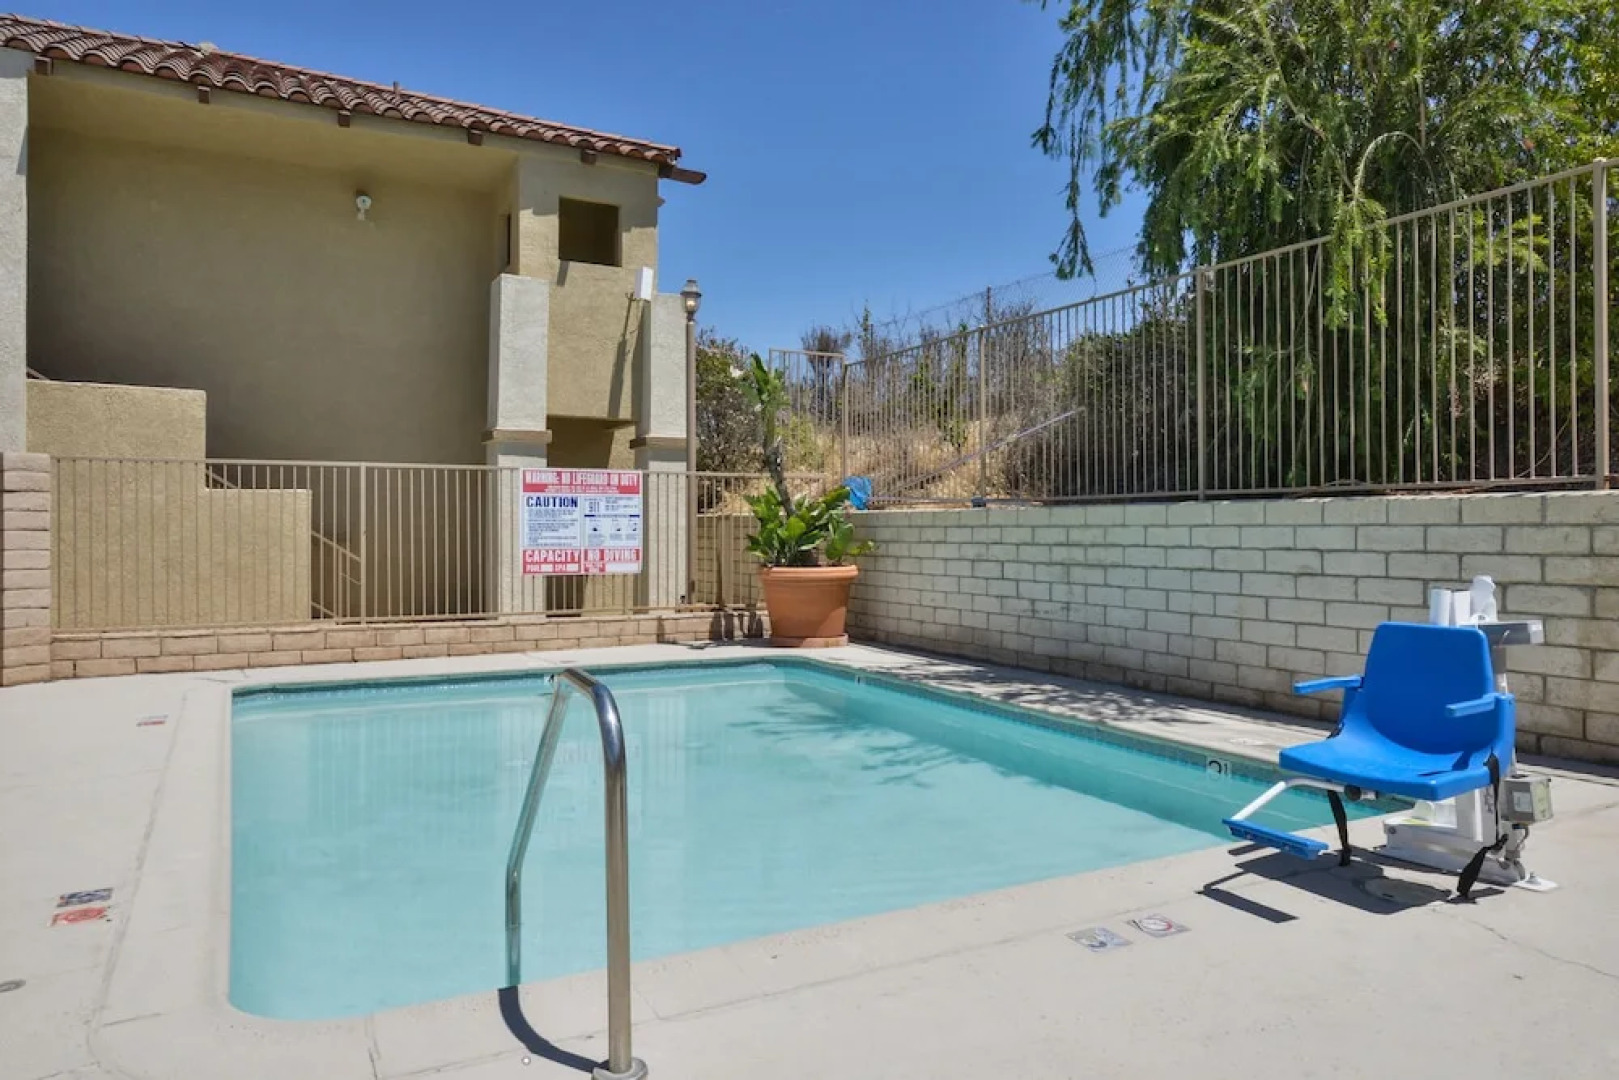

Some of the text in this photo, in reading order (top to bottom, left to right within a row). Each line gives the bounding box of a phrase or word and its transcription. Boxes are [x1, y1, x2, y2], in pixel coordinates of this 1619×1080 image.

[572, 472, 608, 485] LIFEGUARD
[621, 473, 638, 487] DUTY
[526, 496, 579, 508] CAUTION
[526, 549, 579, 563] CAPACITY
[587, 549, 636, 562] NO DIVING
